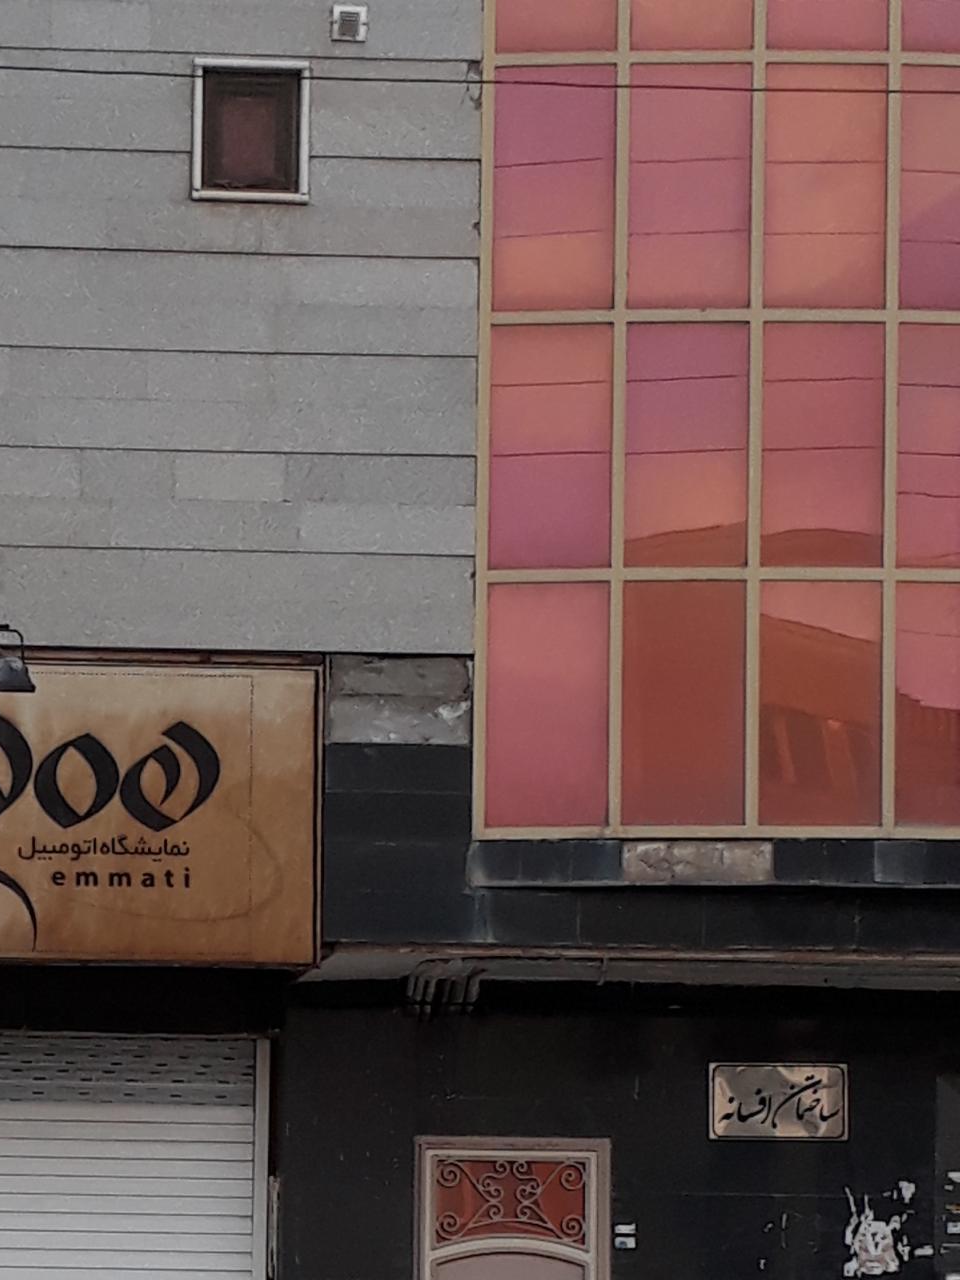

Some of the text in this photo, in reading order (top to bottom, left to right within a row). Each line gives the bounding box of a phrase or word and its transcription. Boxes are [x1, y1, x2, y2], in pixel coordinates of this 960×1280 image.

[17, 835, 190, 861] نمایشگاه اتومبیل
[51, 867, 190, 888] emmati
[718, 1074, 841, 1129] ساختمان افسانه
